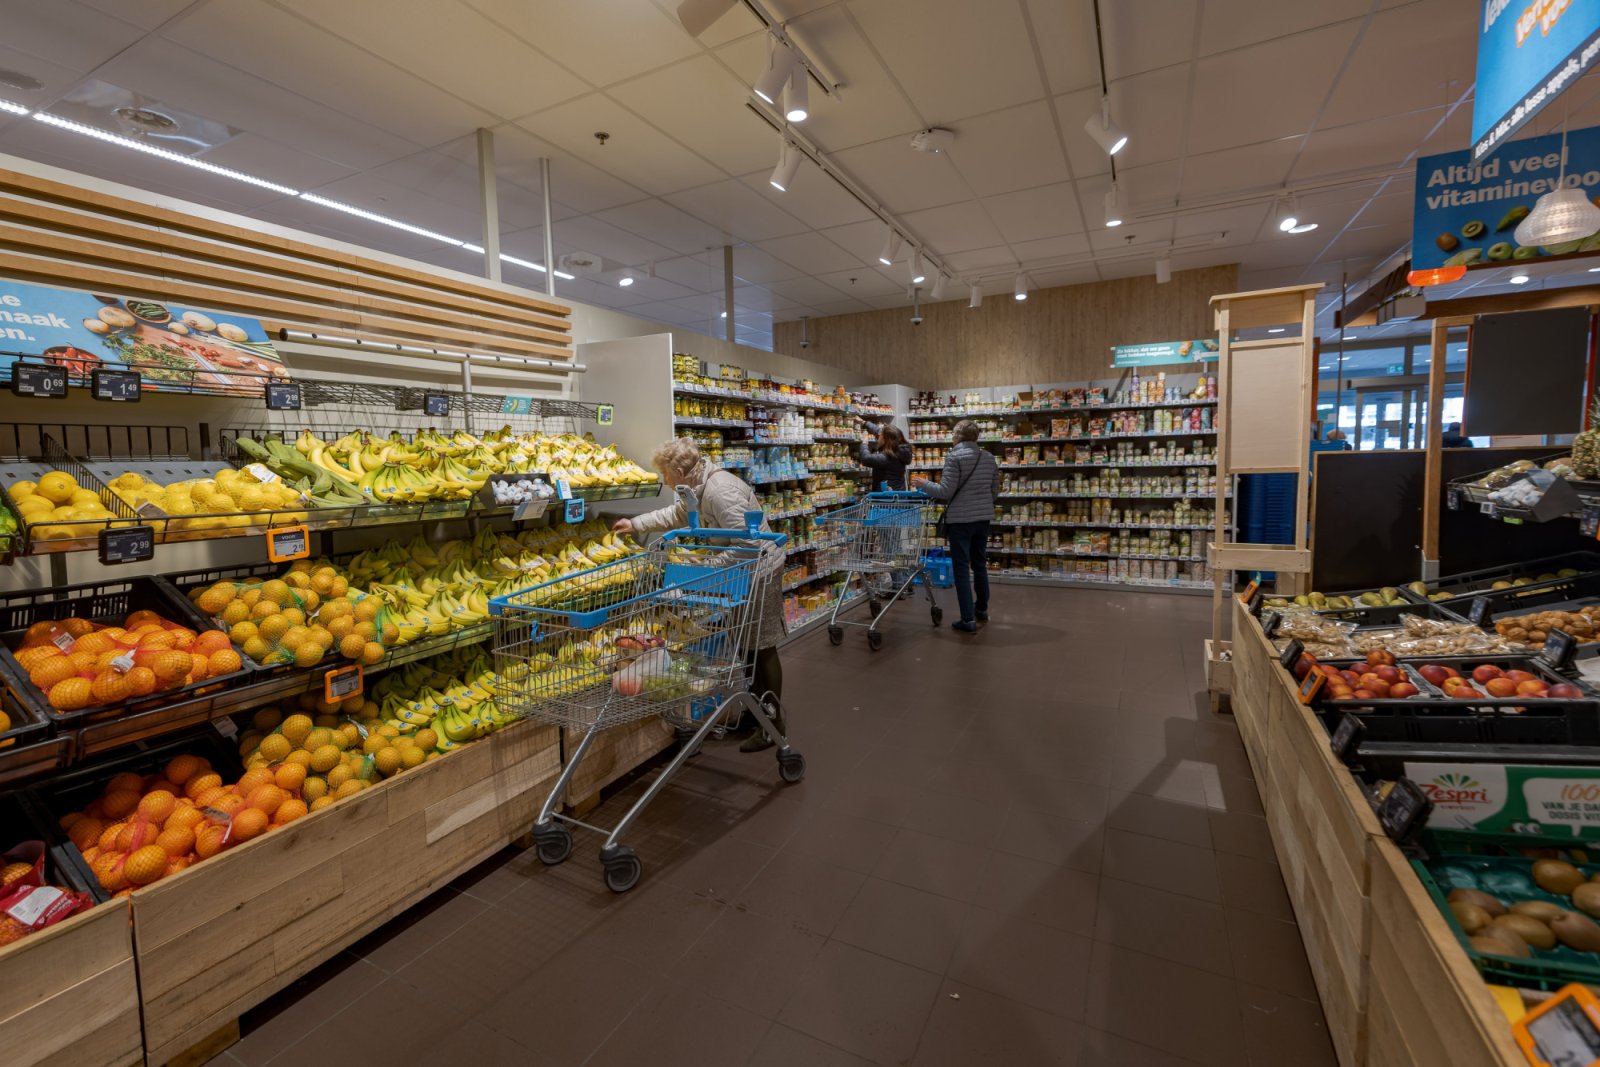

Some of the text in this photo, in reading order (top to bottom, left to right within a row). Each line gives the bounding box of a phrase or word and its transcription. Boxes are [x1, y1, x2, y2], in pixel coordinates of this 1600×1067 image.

[1427, 146, 1568, 188] Altijd veel
[0, 295, 21, 306] e
[1419, 783, 1489, 804] Zespri
[1541, 801, 1564, 809] VAN
[1568, 803, 1581, 811] JE
[1548, 810, 1581, 820] DOSIS
